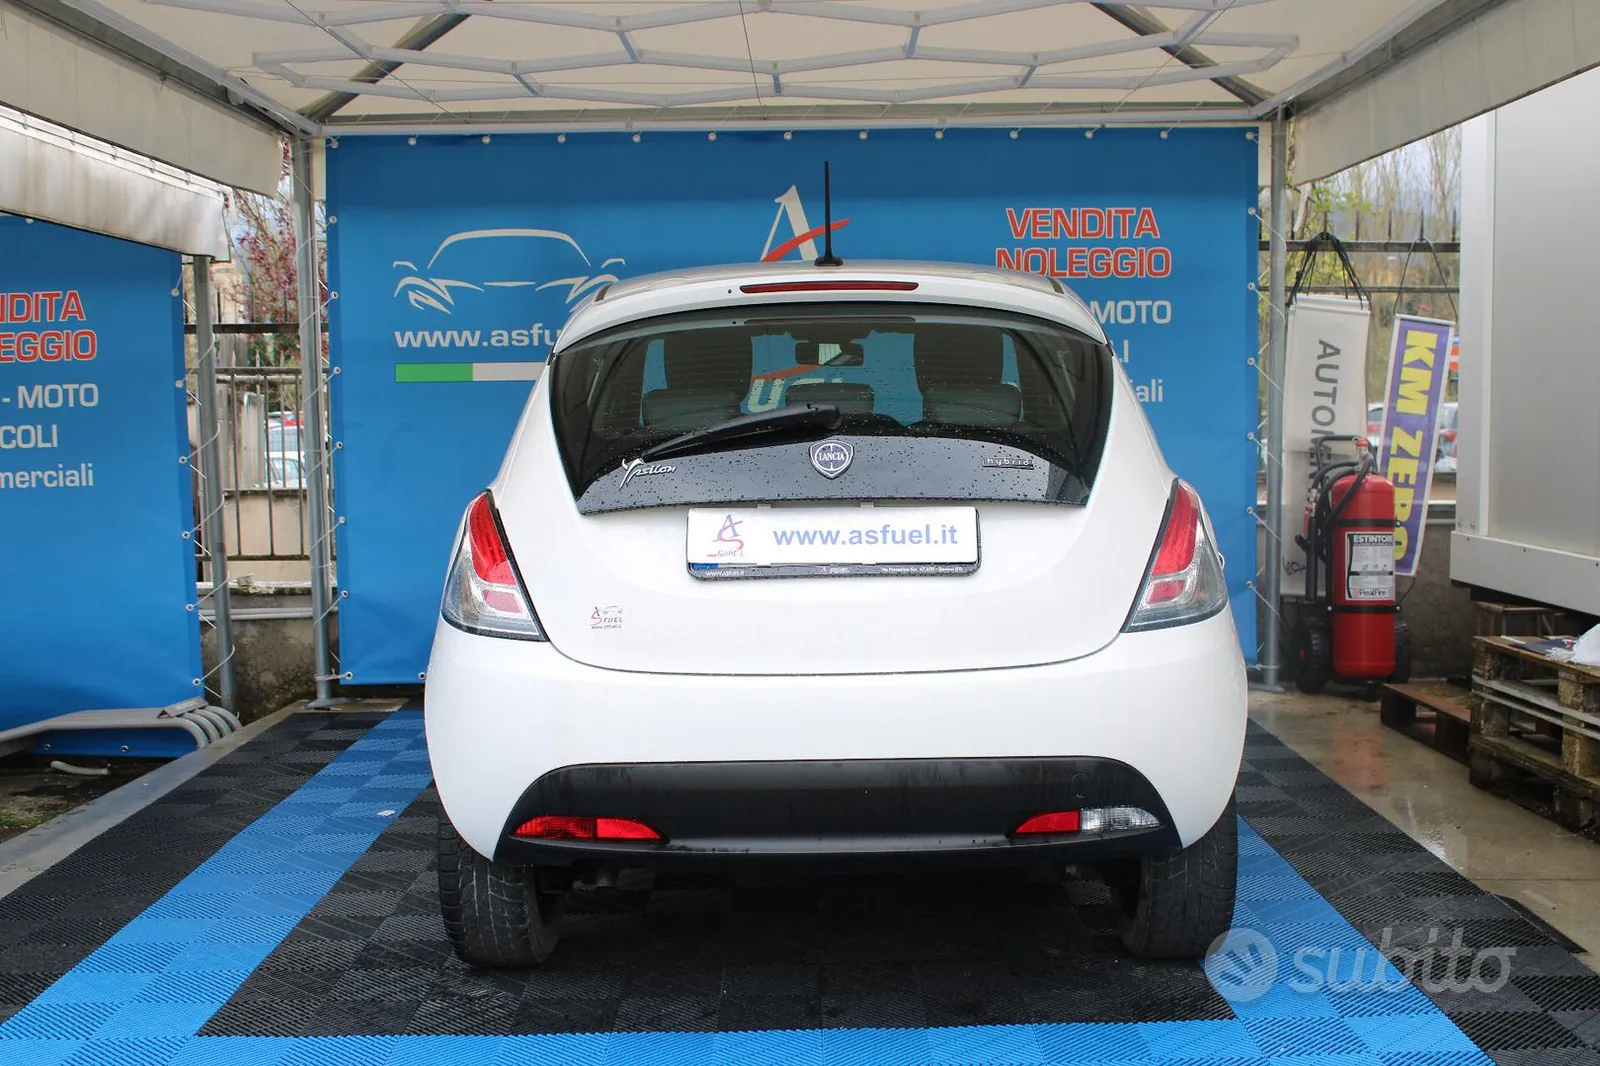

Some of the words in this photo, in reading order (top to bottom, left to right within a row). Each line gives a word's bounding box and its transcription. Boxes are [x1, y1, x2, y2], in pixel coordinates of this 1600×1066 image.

[1005, 207, 1160, 239] VENDITA
[995, 246, 1172, 278] NOLEGGIO
[0, 290, 87, 323] DITA
[1396, 330, 1438, 416] KM
[17, 383, 99, 409] MOTO
[818, 452, 845, 462] LANCIA
[986, 458, 1030, 466] hybrid
[618, 458, 677, 491] Ypsilon
[773, 524, 958, 546] www.asfuel.it
